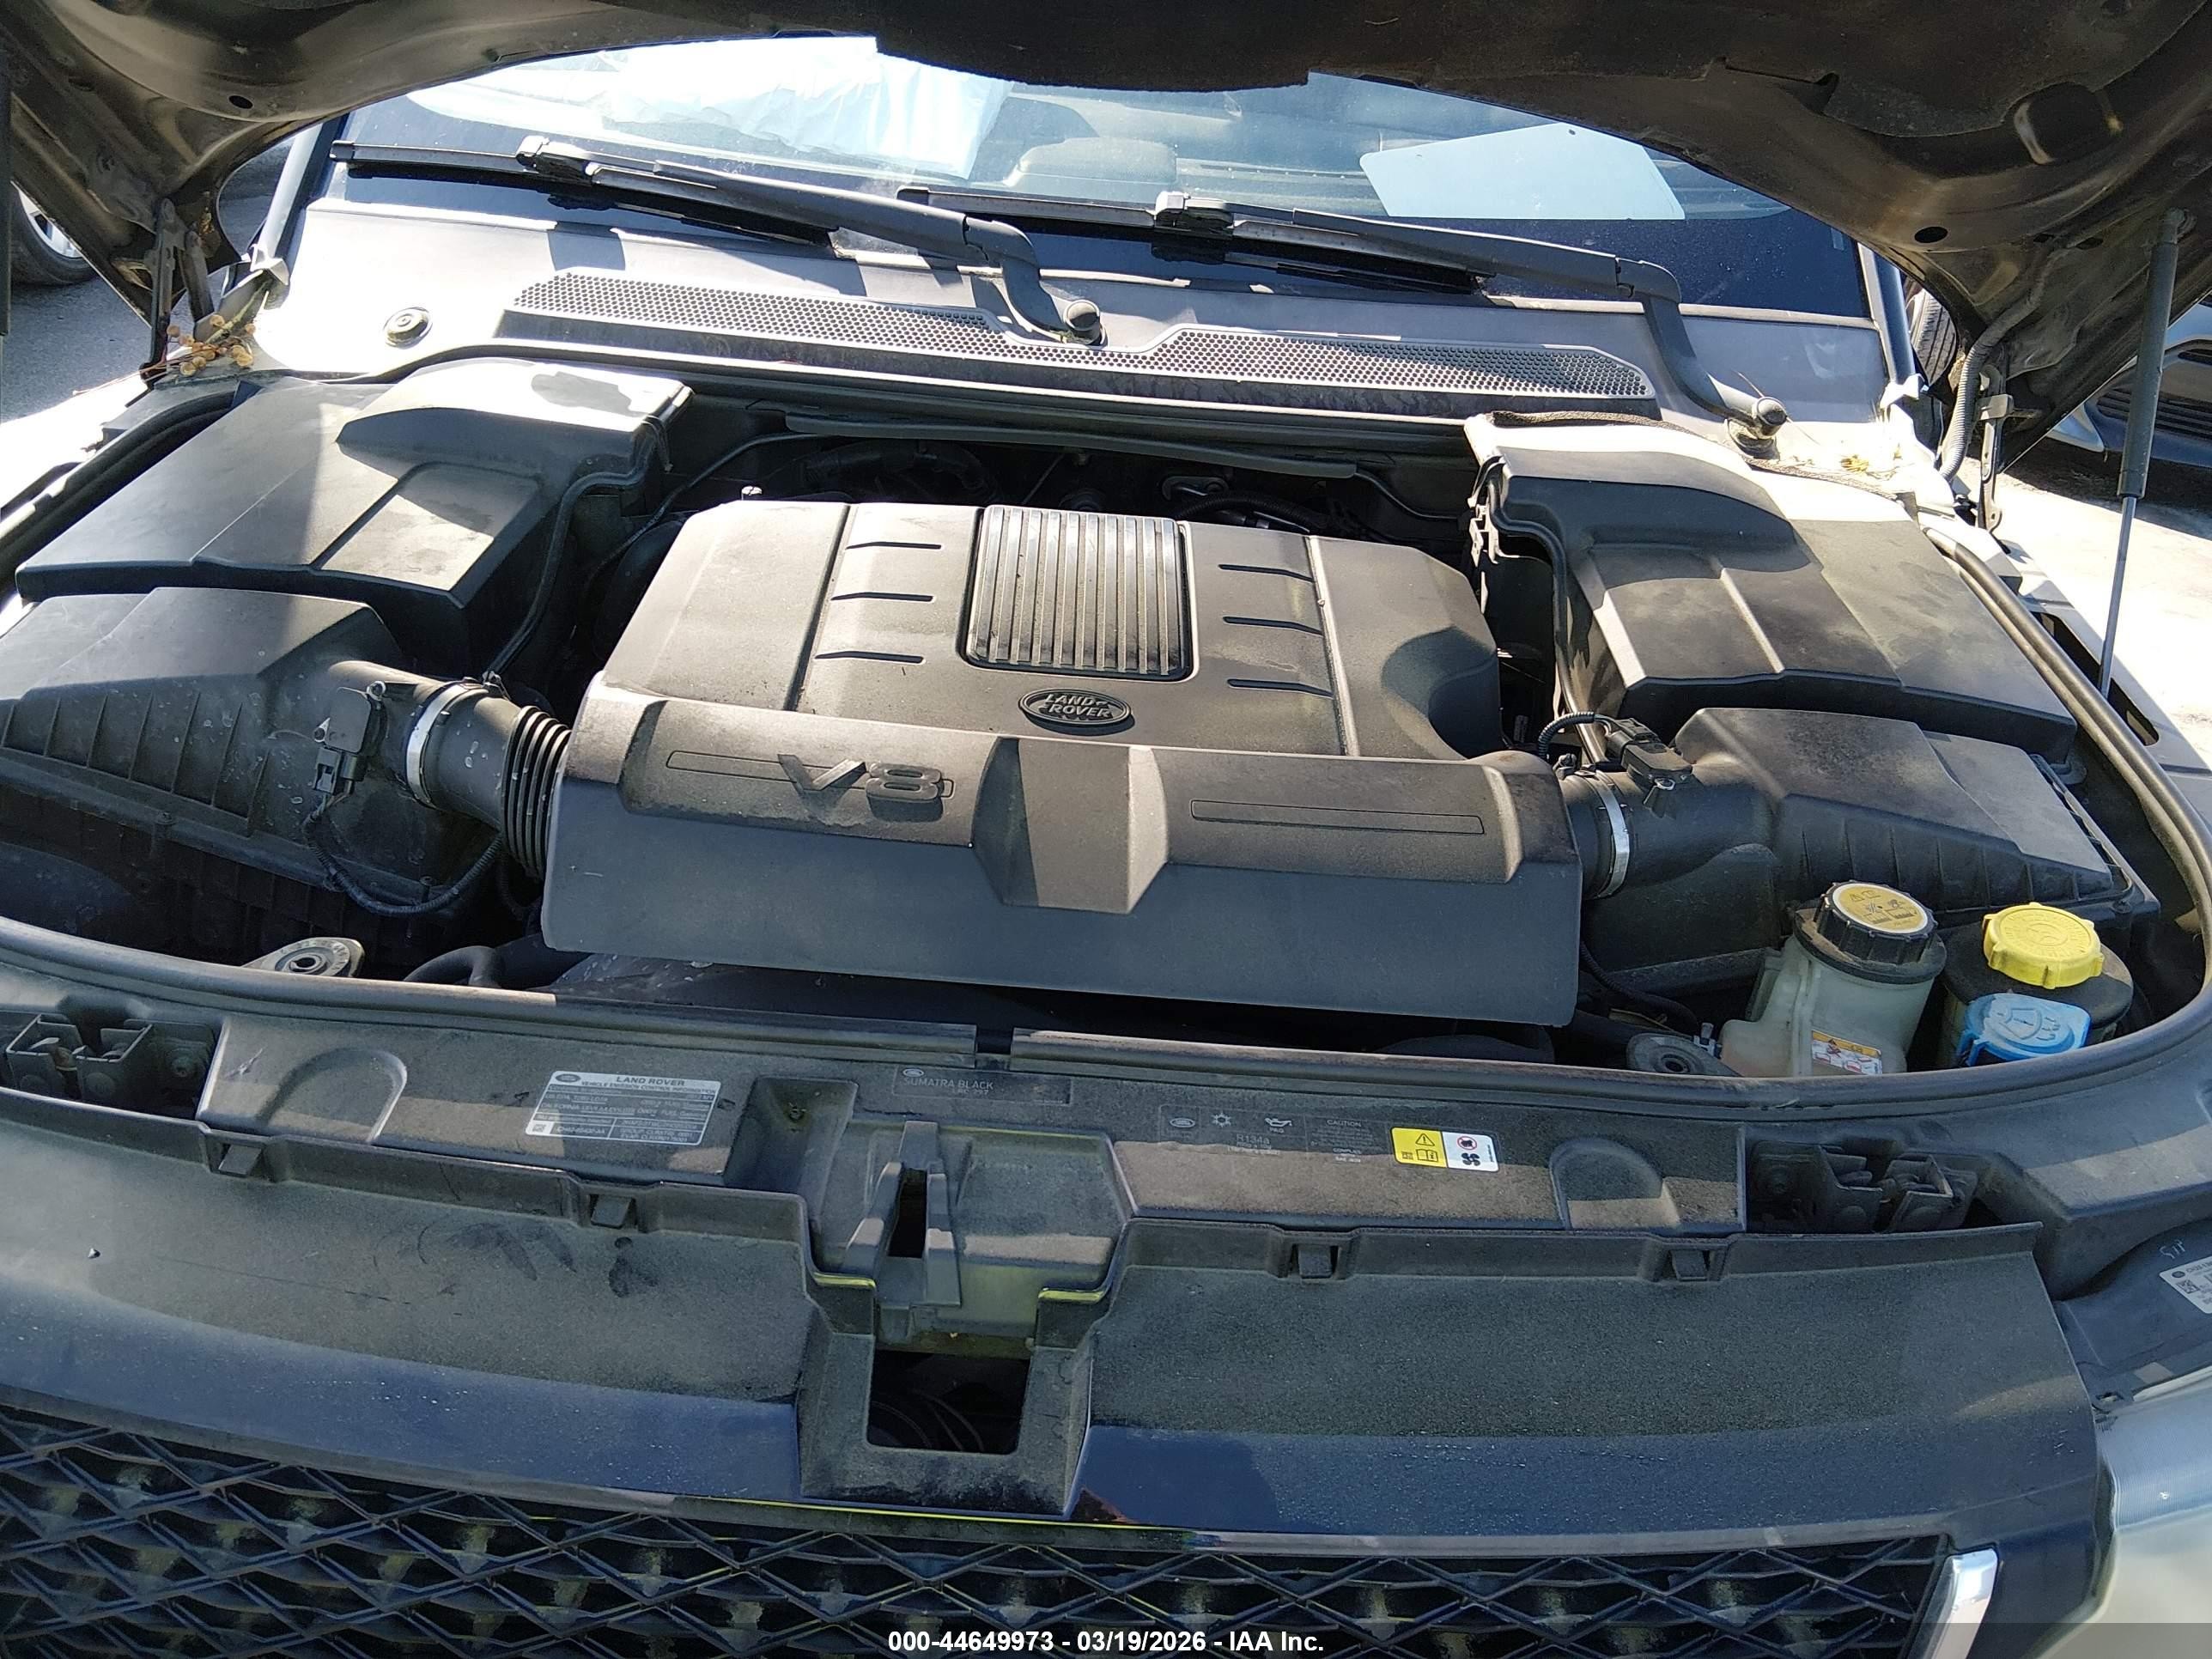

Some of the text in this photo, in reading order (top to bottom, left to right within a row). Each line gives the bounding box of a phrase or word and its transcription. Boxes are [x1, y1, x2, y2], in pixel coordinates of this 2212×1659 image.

[1044, 693, 1097, 707] LAND
[1048, 703, 1111, 718] ROVER
[777, 753, 942, 803] V8
[617, 1075, 685, 1086] LAND ROVER
[902, 1077, 994, 1091] SUMATRA BLACK
[1327, 1119, 1362, 1127] CAUTION
[1236, 1133, 1270, 1146] R134a
